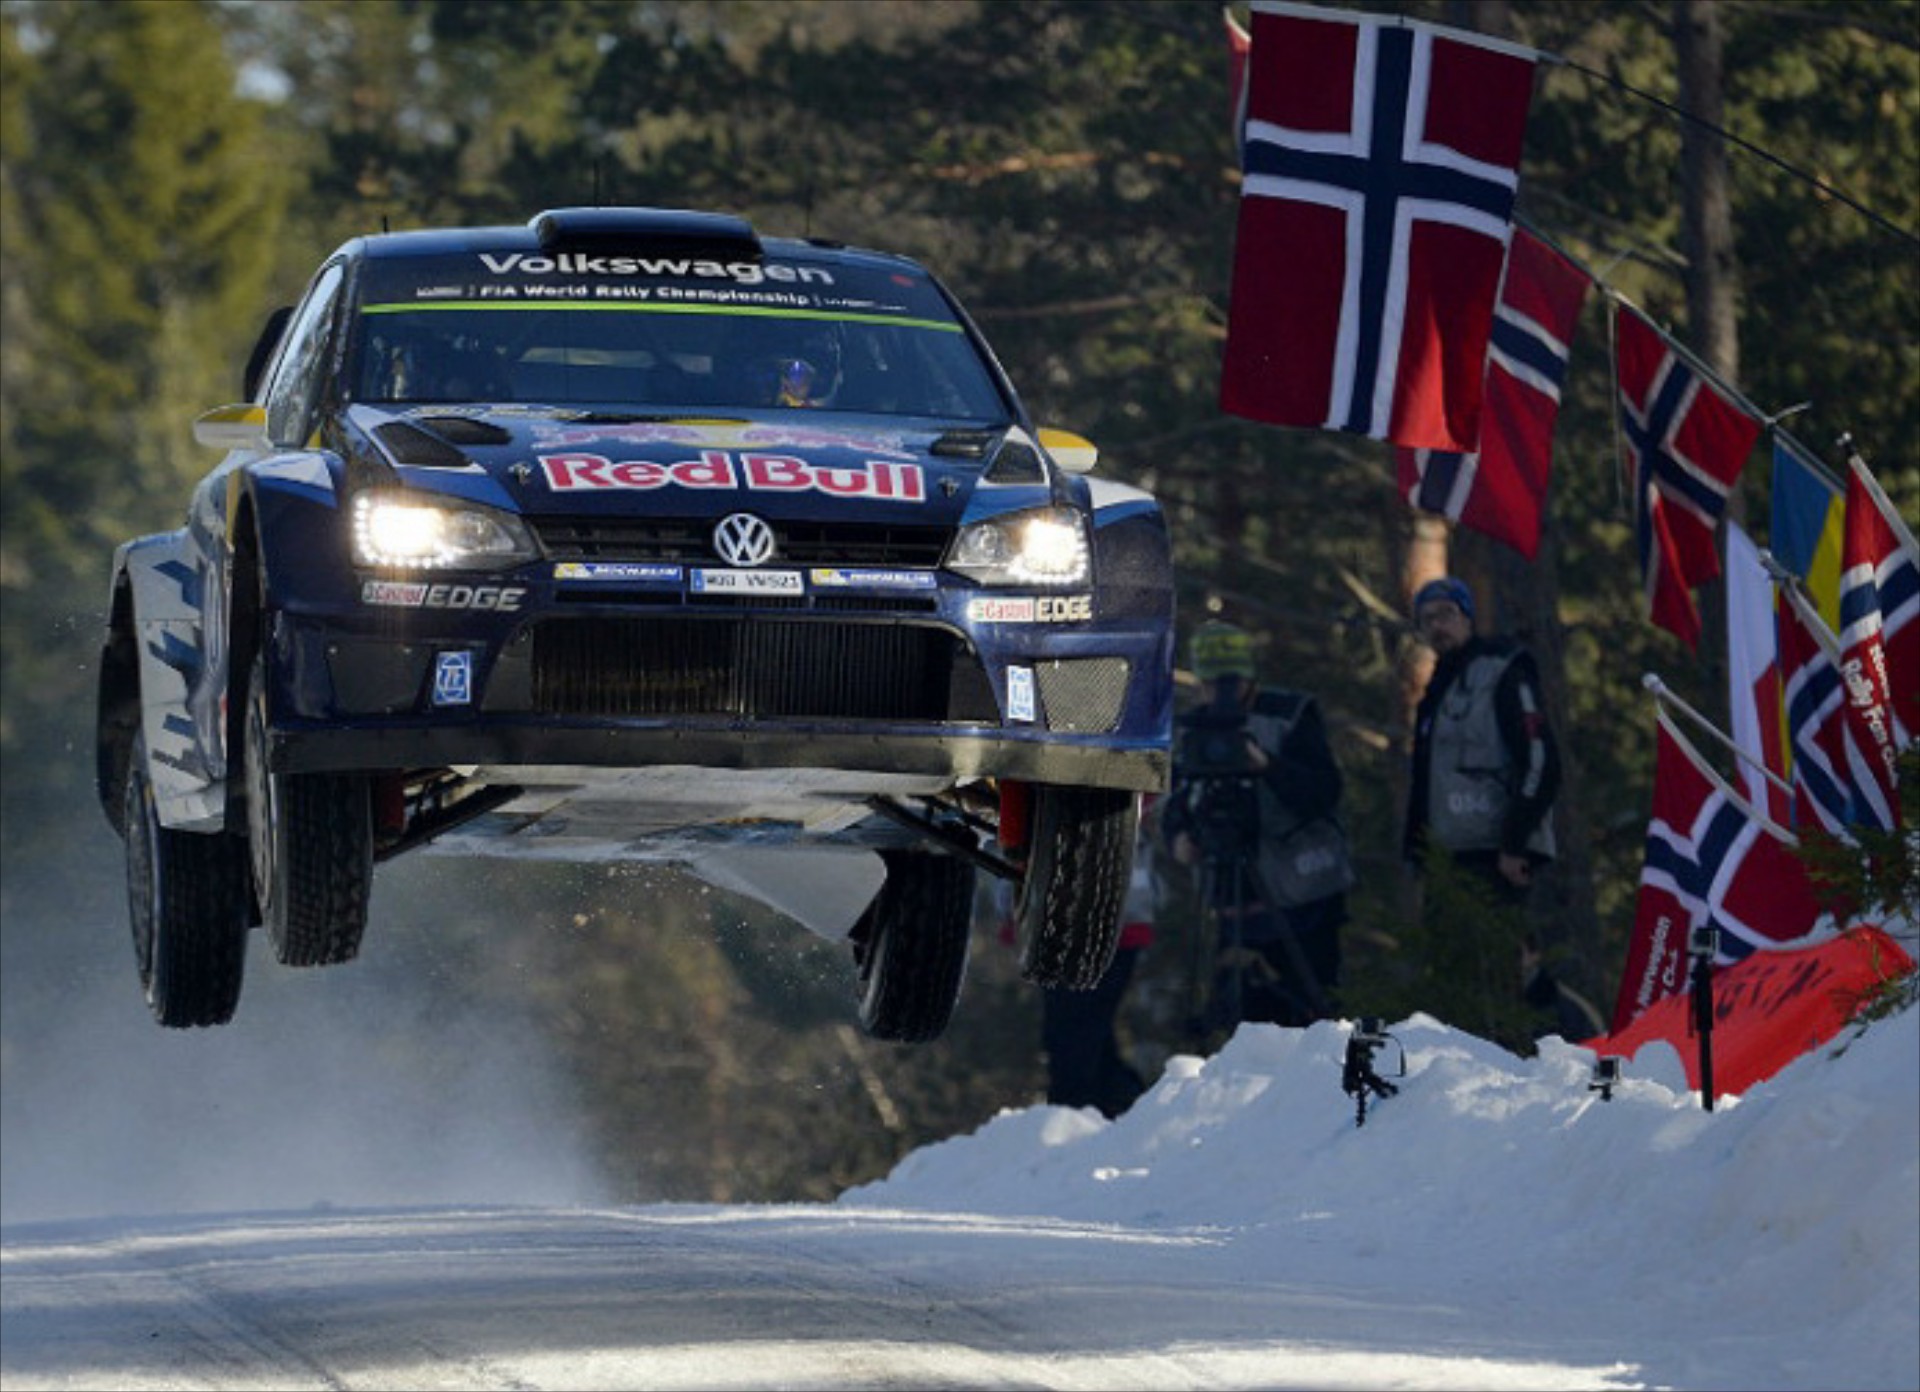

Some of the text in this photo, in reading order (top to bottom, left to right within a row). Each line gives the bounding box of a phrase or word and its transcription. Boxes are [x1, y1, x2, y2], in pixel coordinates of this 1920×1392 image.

[478, 253, 835, 285] Volkswagen
[480, 285, 518, 297] FIA
[524, 285, 588, 297] World
[595, 285, 651, 299] Rally
[656, 286, 810, 305] Championship
[538, 452, 926, 502] Red Bull
[425, 584, 527, 611] EDGE
[1036, 596, 1092, 622] EDGE
[1841, 657, 1874, 707] Rally
[1862, 703, 1888, 745] Fan
[1637, 915, 1671, 1007] Norwegian
